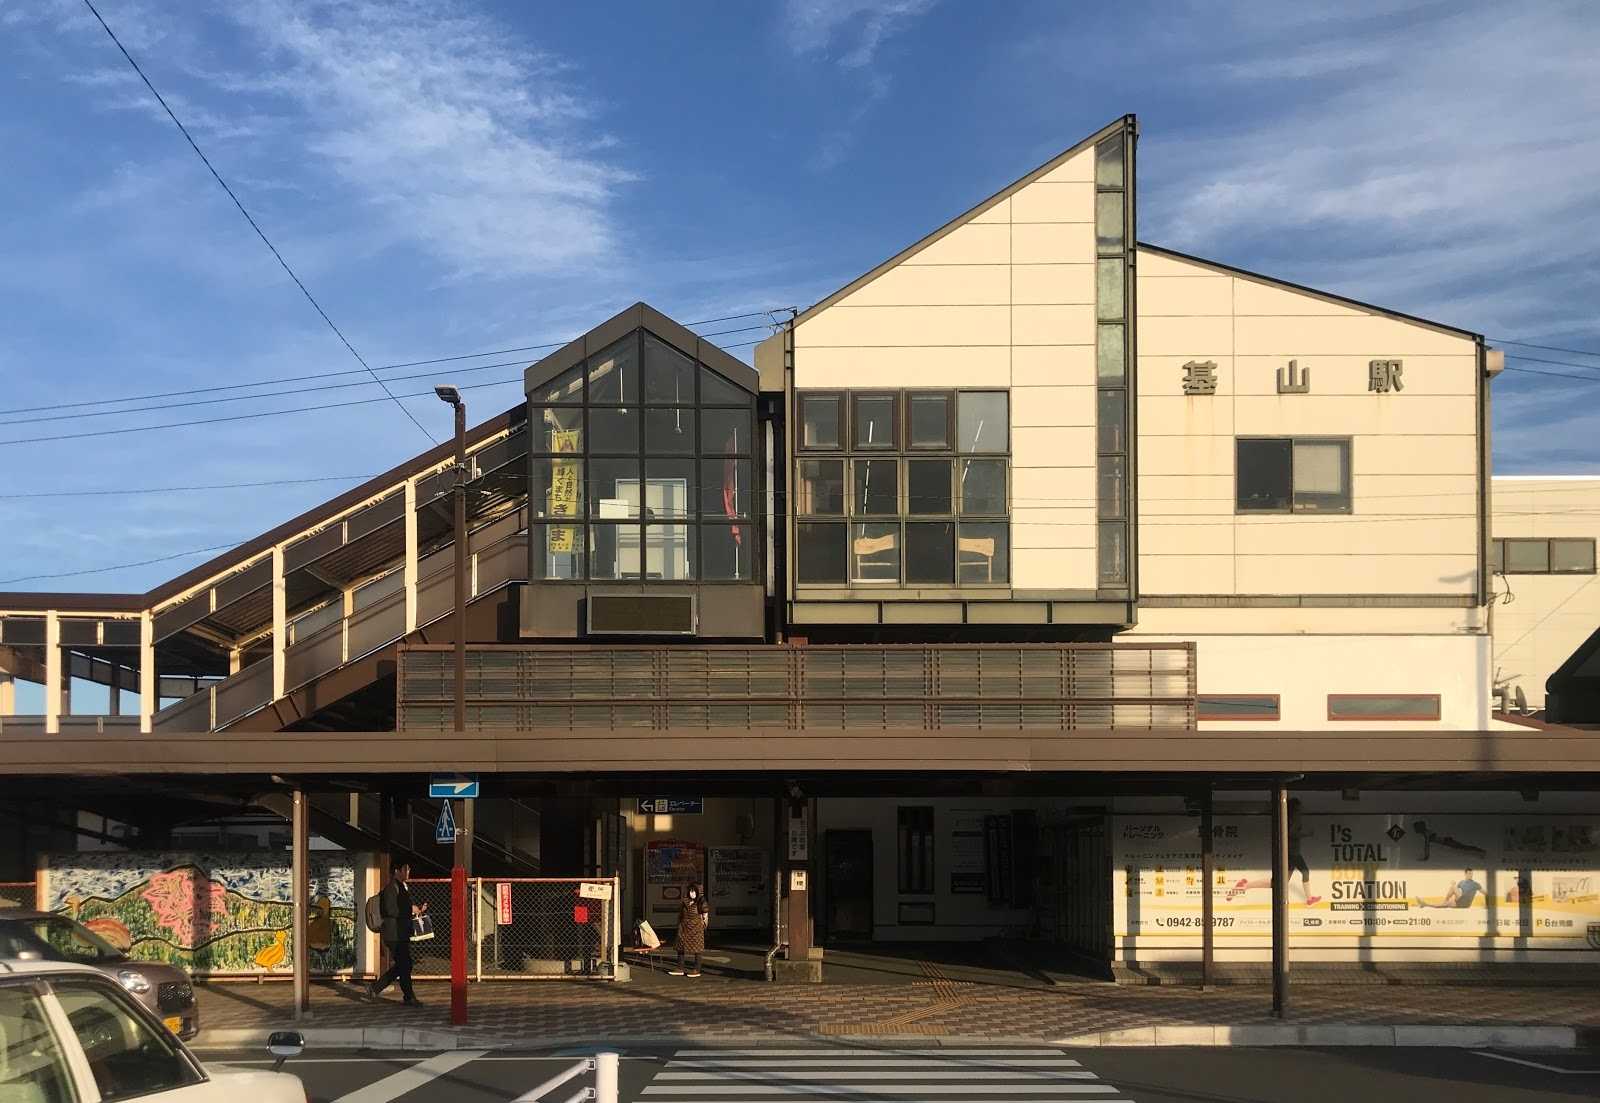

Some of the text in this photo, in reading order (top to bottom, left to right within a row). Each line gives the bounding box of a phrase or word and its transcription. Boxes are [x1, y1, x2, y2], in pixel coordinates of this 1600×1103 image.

[1182, 360, 1404, 395] 基山駅
[1331, 824, 1353, 842] I's
[1331, 844, 1387, 862] TOTAL
[1331, 881, 1407, 899] STATION
[1408, 918, 1431, 926] 21:00
